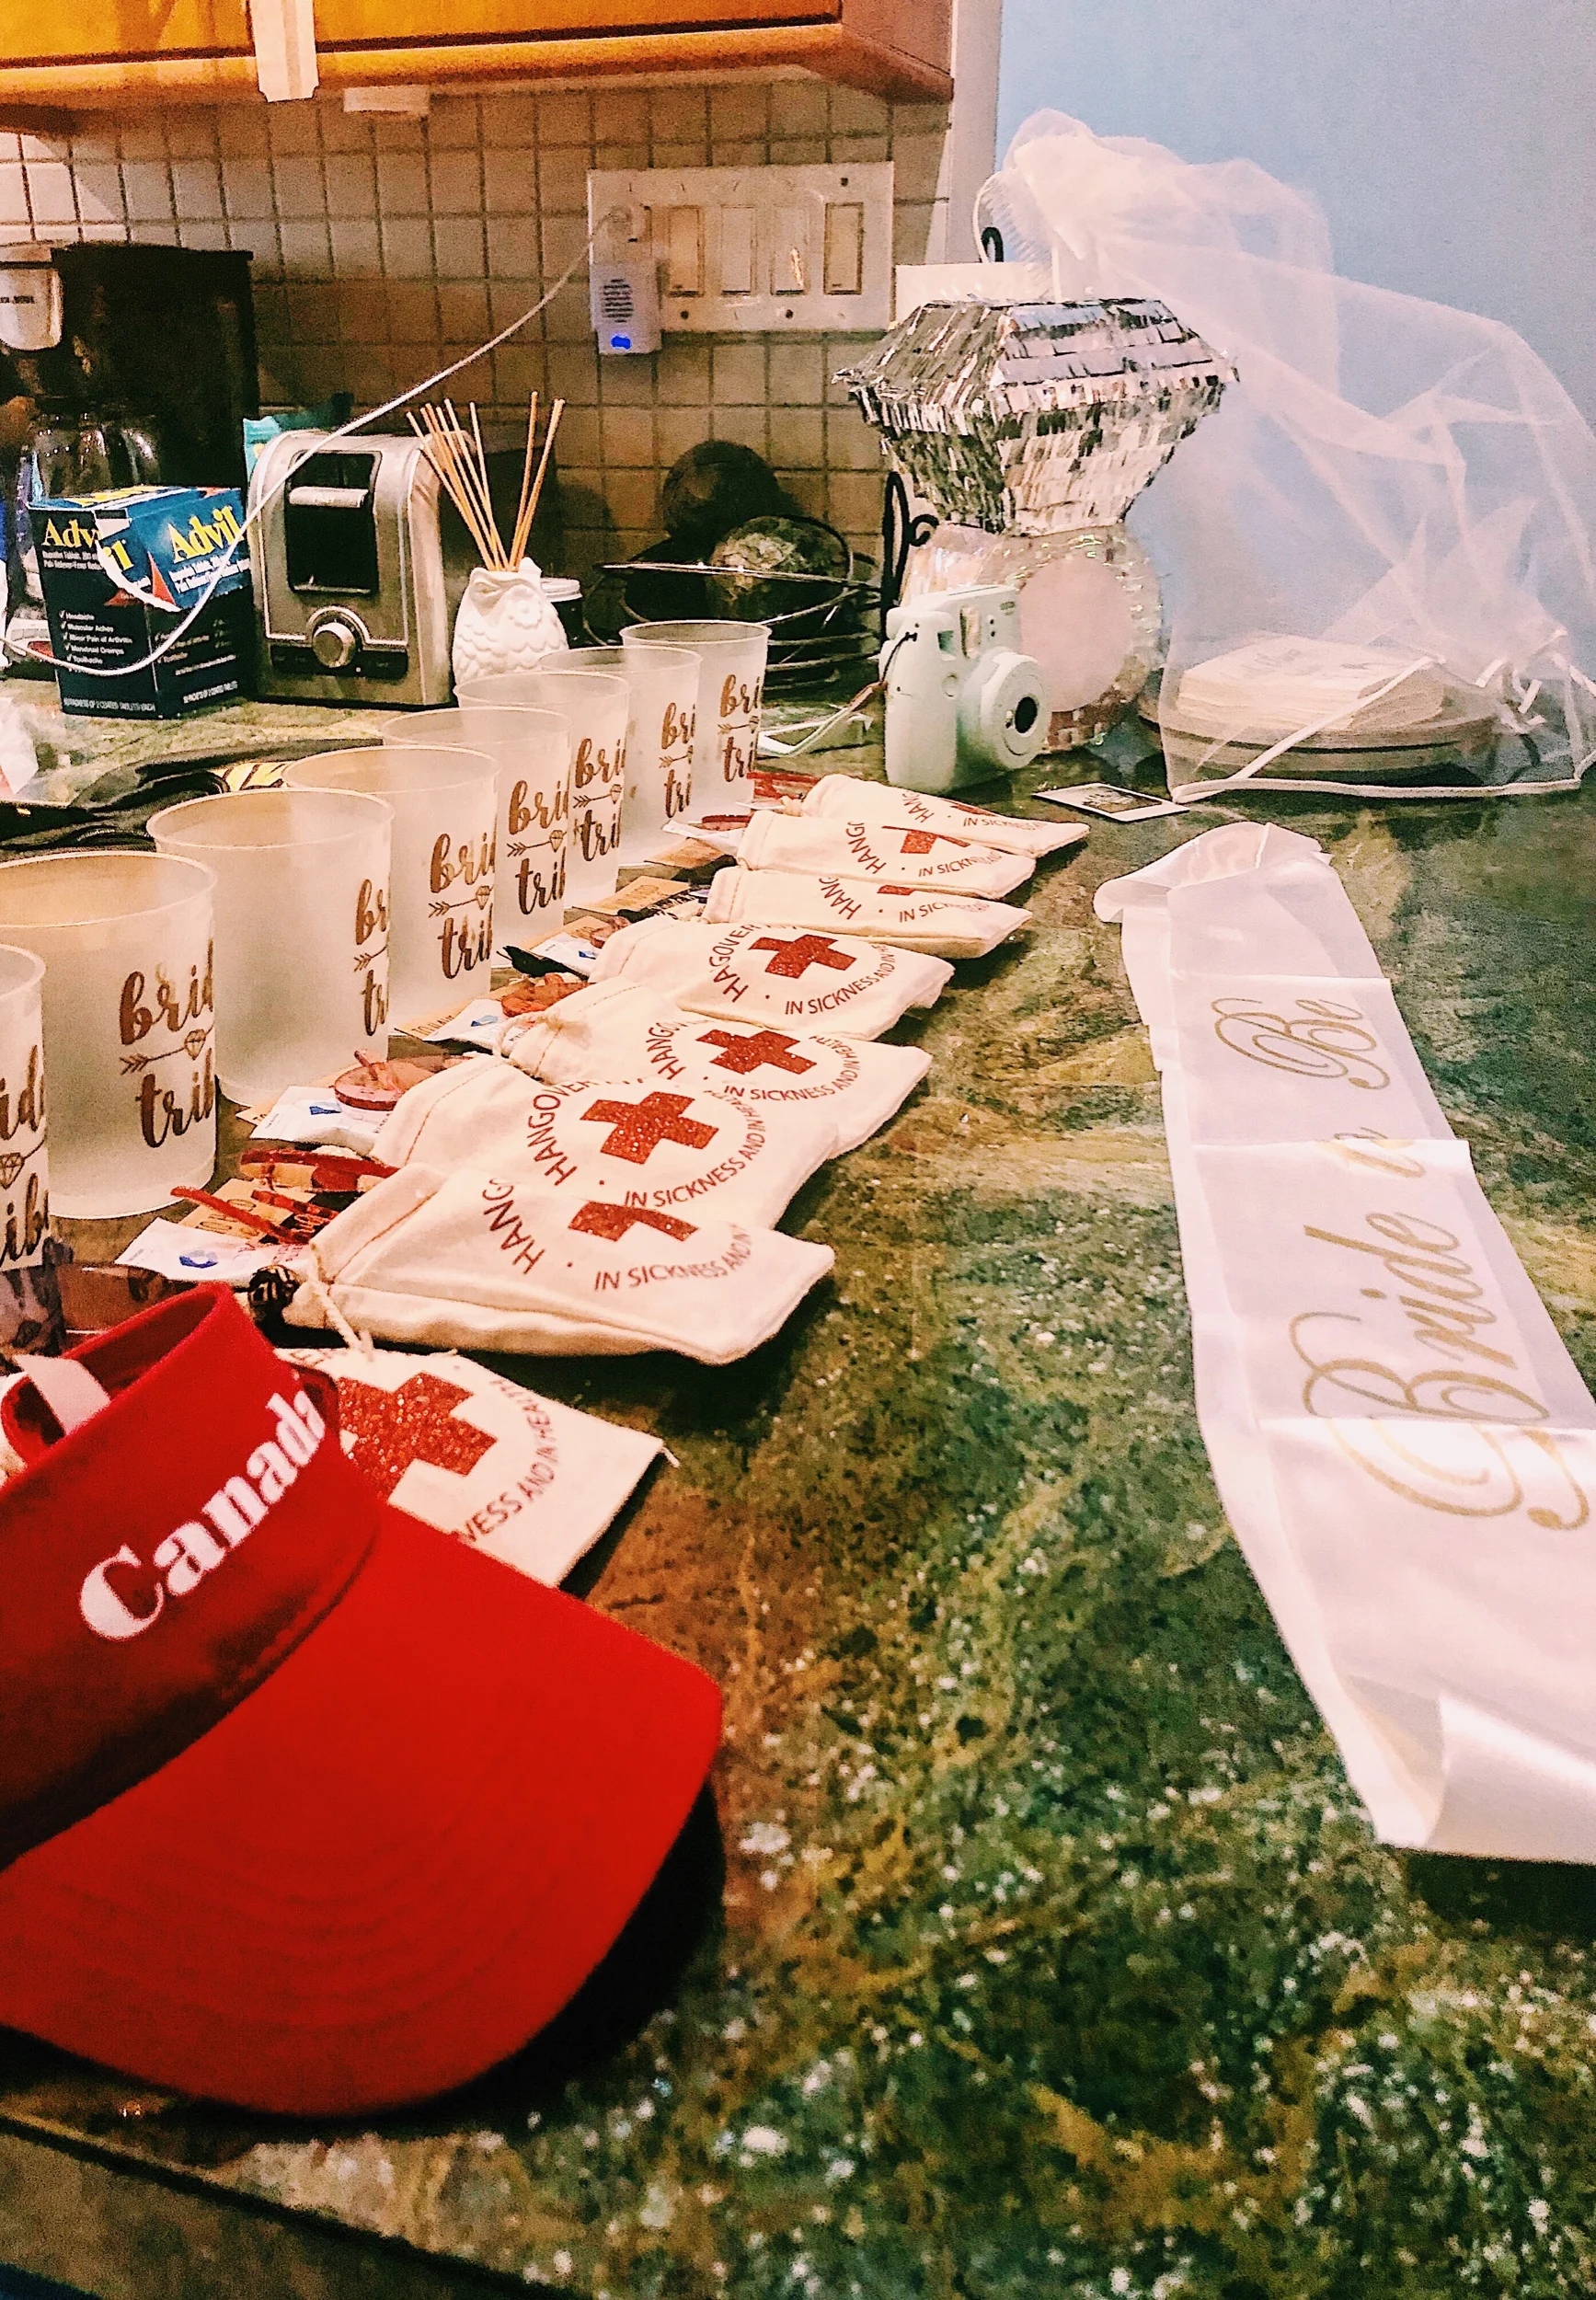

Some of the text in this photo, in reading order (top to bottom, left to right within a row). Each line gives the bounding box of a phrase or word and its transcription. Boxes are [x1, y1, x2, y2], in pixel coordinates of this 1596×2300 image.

[168, 505, 244, 564] Advil
[963, 817, 979, 827] IN
[918, 866, 934, 877] IN
[899, 908, 915, 923] IN
[785, 1000, 803, 1015] IN
[808, 975, 880, 1015] SICKNESS
[1211, 996, 1391, 1090] Be
[724, 1085, 745, 1098] IN
[750, 1085, 836, 1101] SICKNESS
[625, 1190, 647, 1207] IN
[652, 1156, 747, 1208] SICKNESS
[593, 1271, 621, 1292] IN
[1288, 1211, 1590, 1531] Bride
